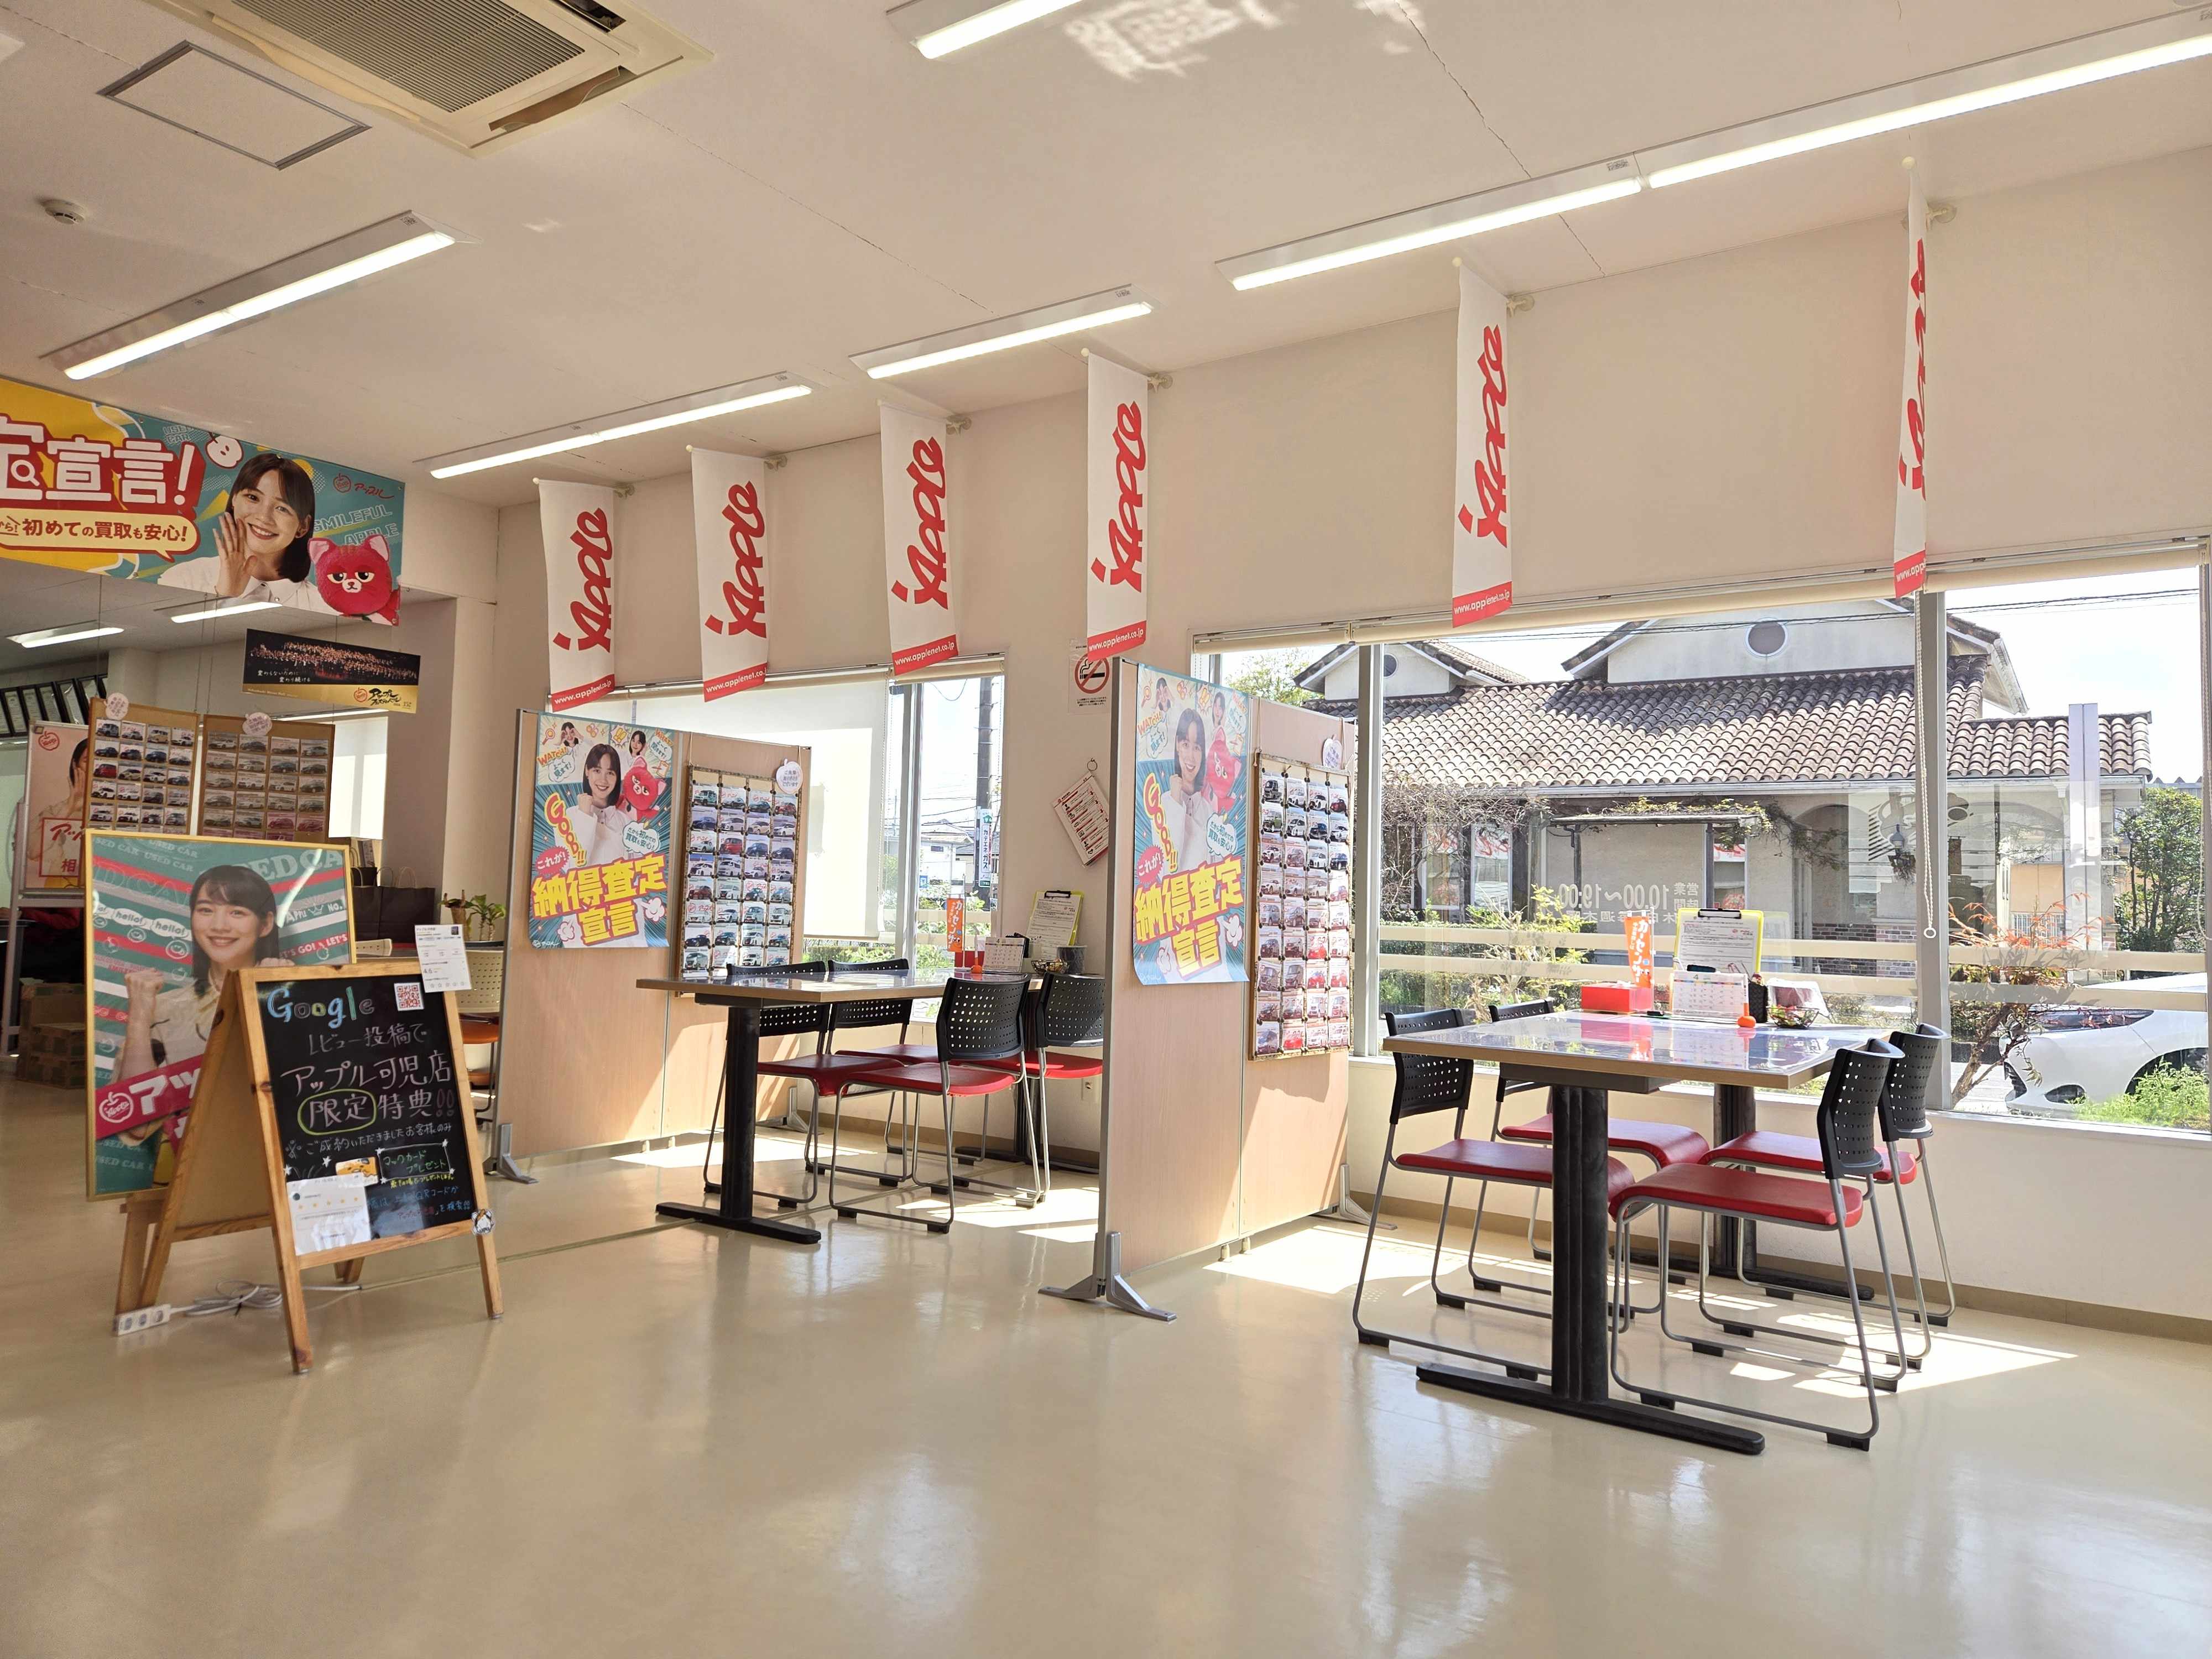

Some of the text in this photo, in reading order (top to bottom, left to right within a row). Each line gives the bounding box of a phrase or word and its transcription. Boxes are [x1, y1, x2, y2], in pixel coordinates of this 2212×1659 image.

[22, 518, 188, 542] 初めての買取も安心!
[314, 504, 393, 533] SMILEFUL
[1454, 589, 1510, 614] www.applenet.co.jp
[1089, 628, 1144, 652] www.applenet.co.jp
[894, 641, 955, 666] www.applenet.co.jp
[554, 680, 612, 705] www.applenet.co.jp
[706, 668, 767, 693] www.applenet.co.j
[1138, 711, 1161, 735] WATCH!
[537, 747, 568, 766] WATCH!
[546, 794, 586, 865] GOOD!!
[626, 833, 655, 851] 買取も安心!
[95, 837, 116, 848] SED
[537, 852, 566, 869] これが!
[1138, 853, 1162, 877] これが!
[532, 854, 666, 917] 納得査定
[1135, 857, 1243, 942] 納得査定
[115, 911, 143, 925] hello!
[155, 920, 186, 936] hello!
[579, 900, 637, 943] 宣言
[947, 900, 963, 950] カーセンサー
[298, 942, 316, 954] GO!
[326, 933, 348, 947] LET'S
[1172, 919, 1222, 977] 宣言
[1632, 919, 1648, 983] カーセンサー
[267, 986, 374, 1029] Google
[309, 1023, 427, 1056] レビュー投稿で
[280, 1050, 451, 1097] アップル可児店
[406, 1160, 447, 1174] プレゼント
